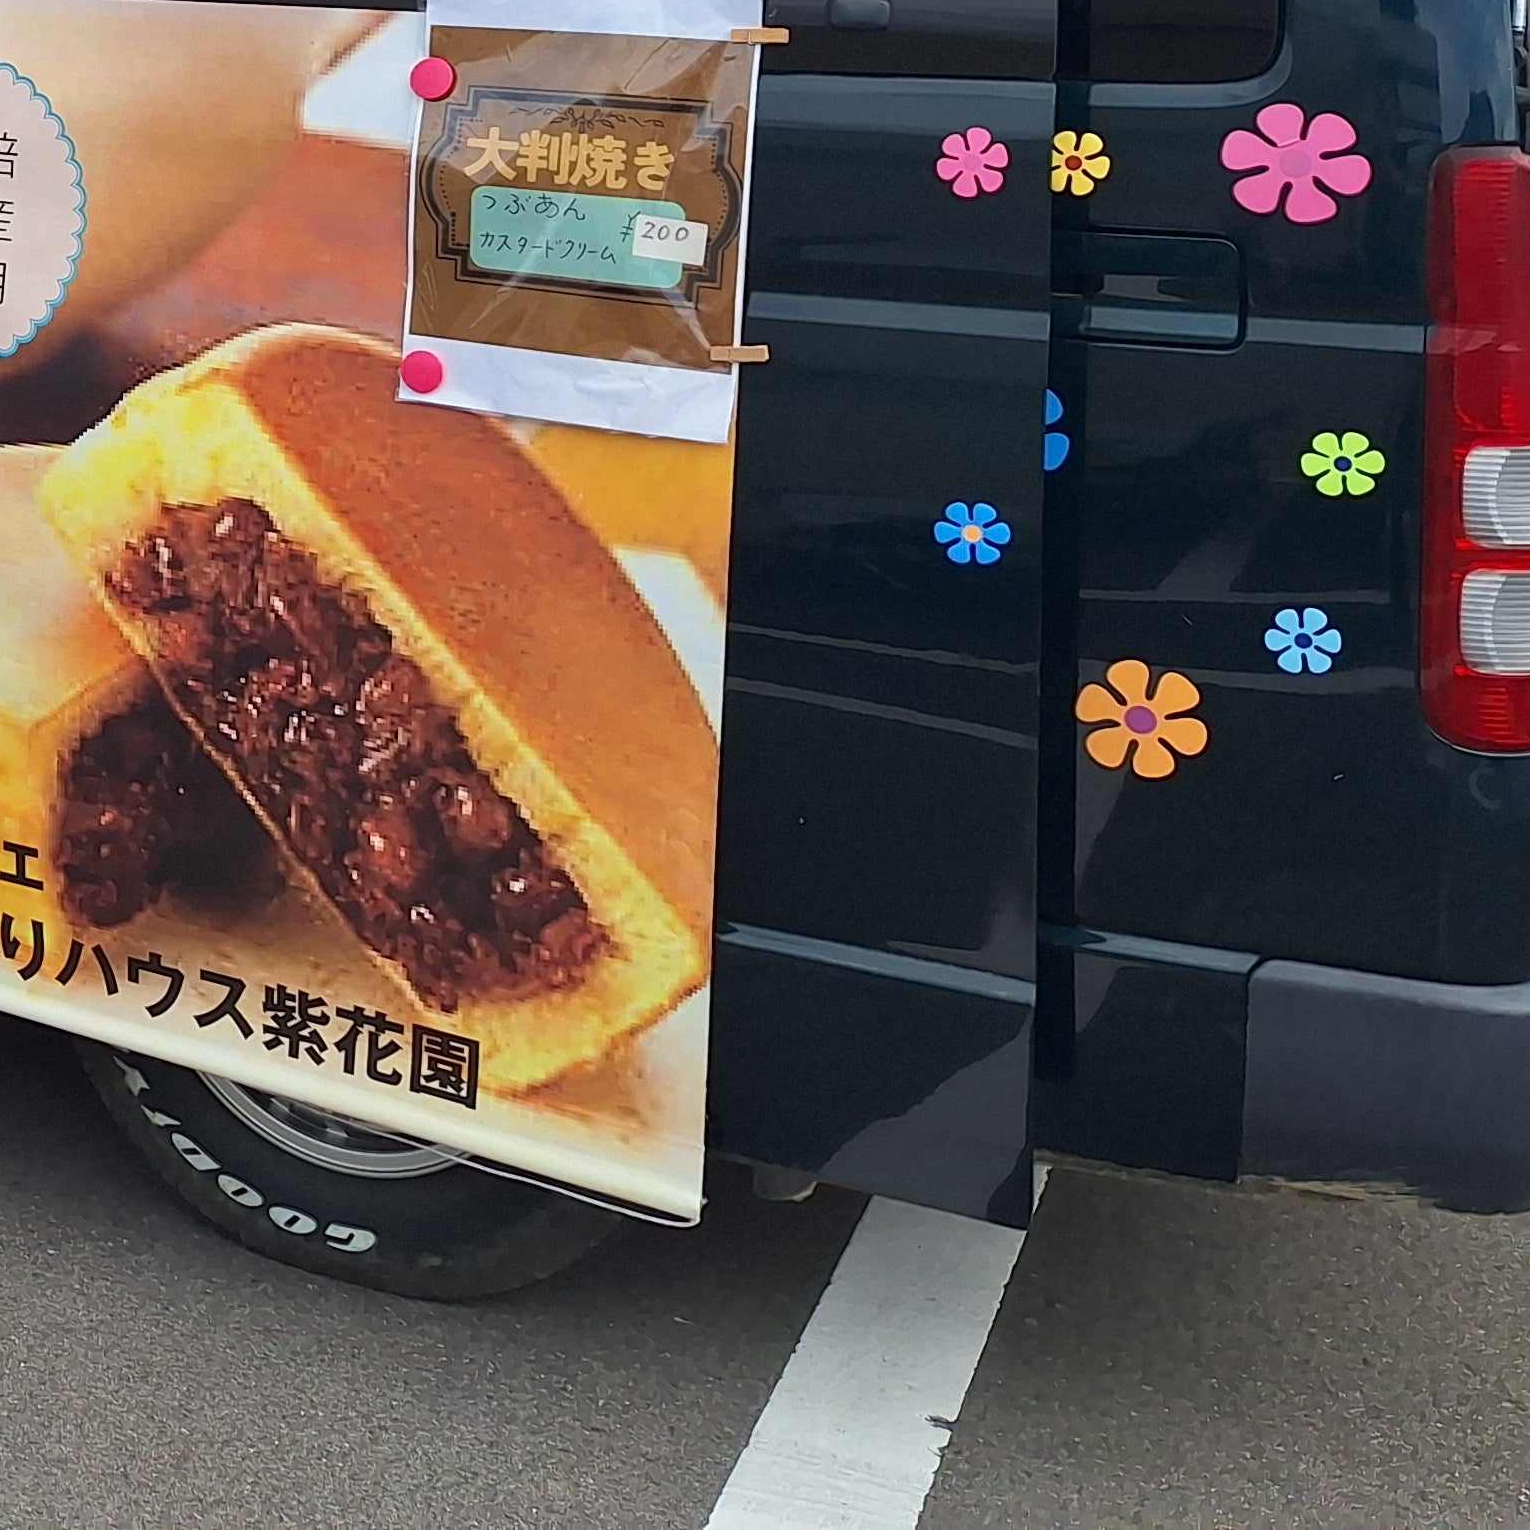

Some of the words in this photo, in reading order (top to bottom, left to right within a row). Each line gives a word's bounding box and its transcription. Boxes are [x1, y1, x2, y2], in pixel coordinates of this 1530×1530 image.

[464, 126, 675, 191] 大判焼き
[481, 193, 586, 221] つぶあん
[480, 231, 617, 264] カスタードクリーム
